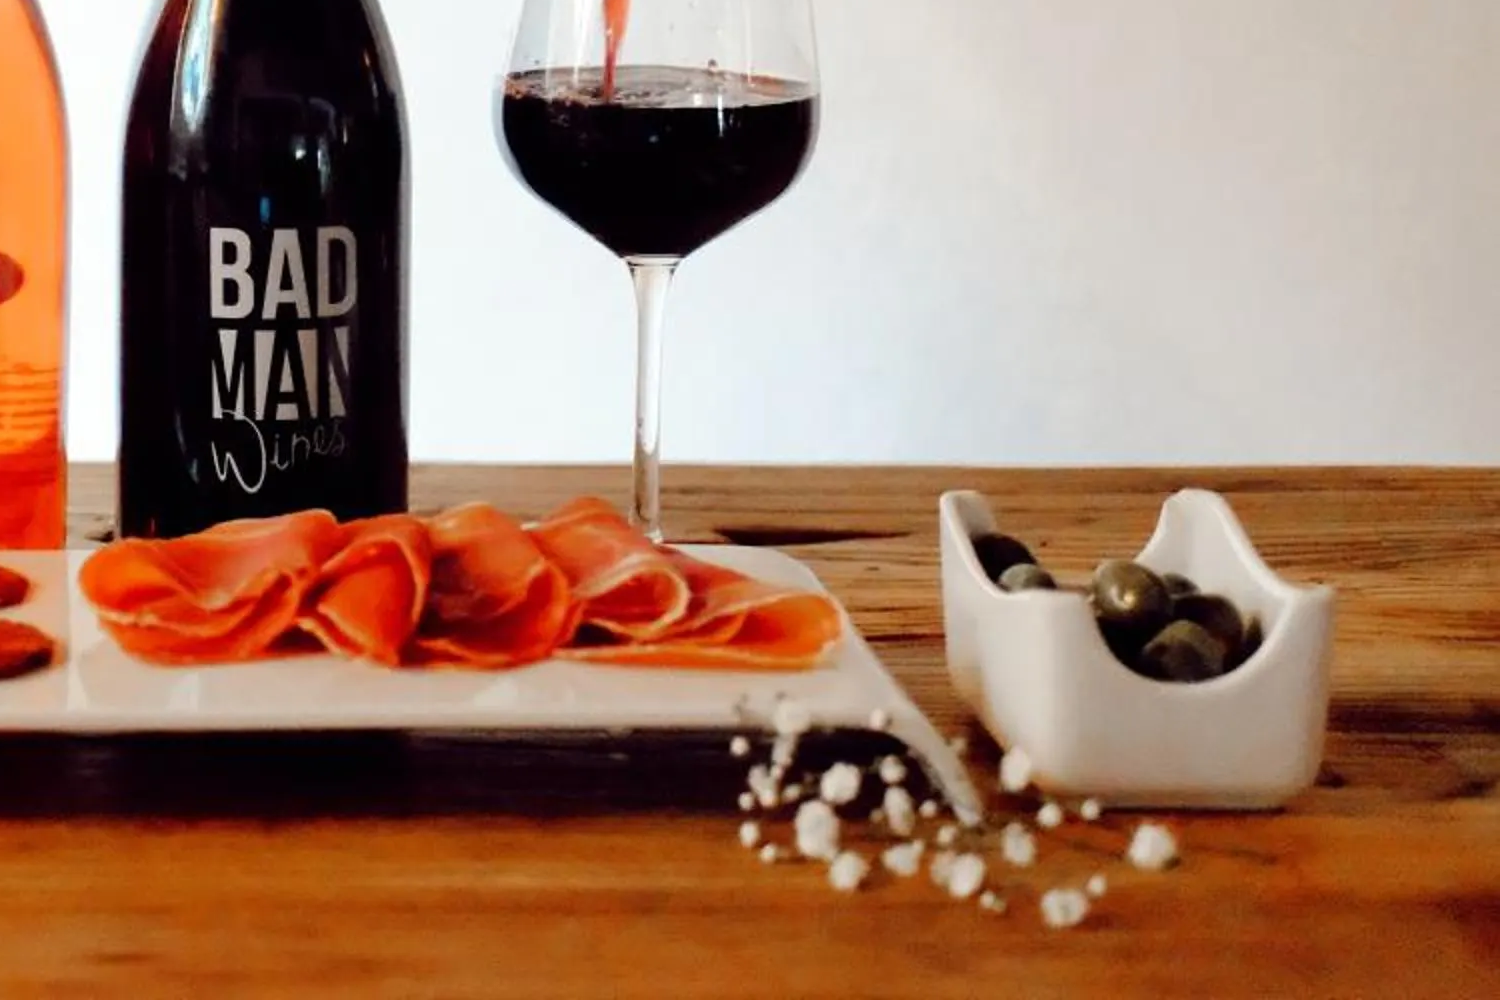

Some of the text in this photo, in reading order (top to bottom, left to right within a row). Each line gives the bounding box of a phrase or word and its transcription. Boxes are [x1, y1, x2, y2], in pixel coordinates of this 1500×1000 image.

[209, 225, 358, 320] BAD
[210, 326, 352, 421] MAN
[210, 408, 348, 493] Wines
